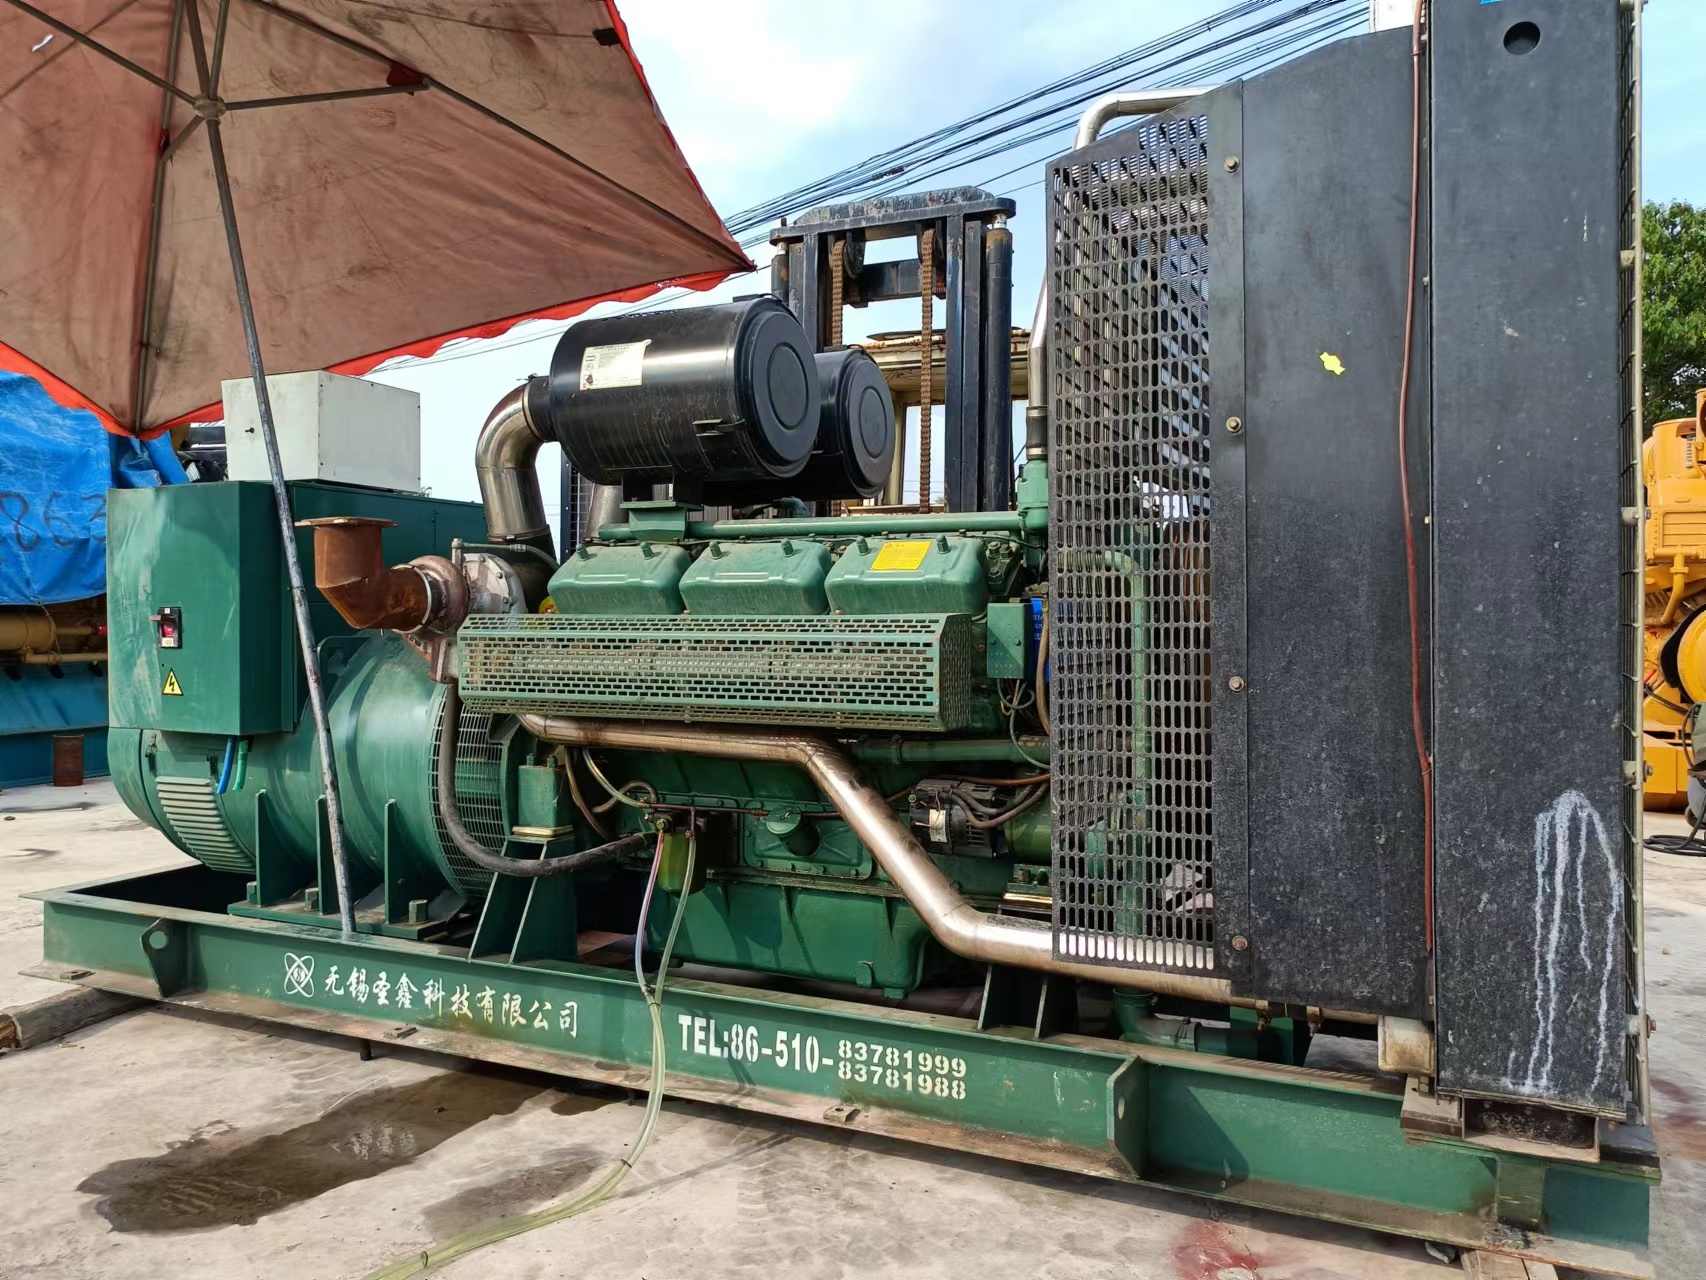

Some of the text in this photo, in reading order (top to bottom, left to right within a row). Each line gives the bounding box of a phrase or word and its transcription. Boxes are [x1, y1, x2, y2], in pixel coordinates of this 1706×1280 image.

[324, 965, 579, 1039] 无锡圣鑫科技有限公司
[837, 1039, 967, 1078] 83781999
[837, 1060, 967, 1100] 83781988
